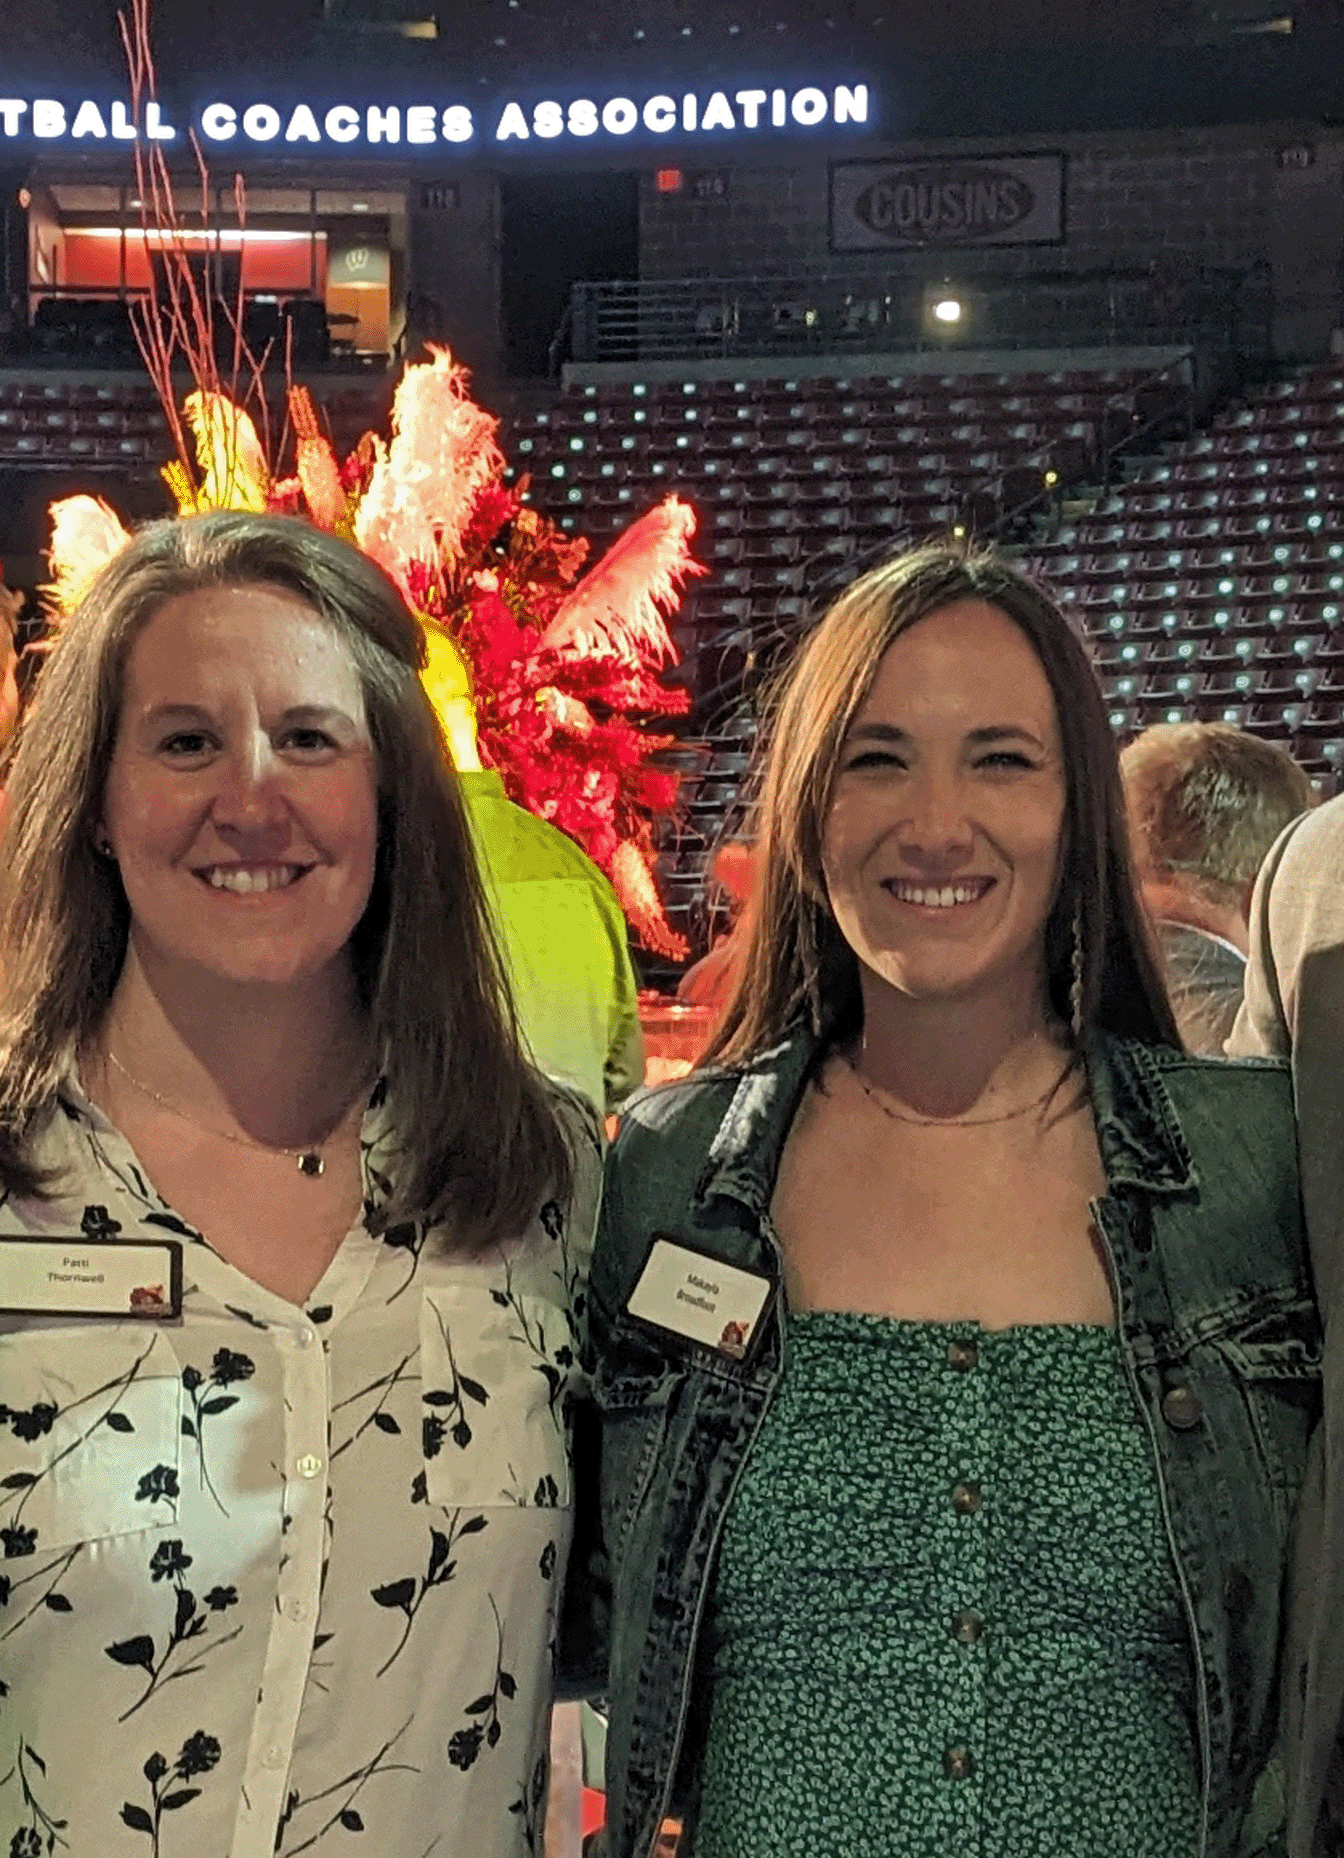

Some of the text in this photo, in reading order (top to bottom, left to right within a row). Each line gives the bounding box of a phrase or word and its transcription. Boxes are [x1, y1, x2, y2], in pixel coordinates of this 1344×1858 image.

[201, 103, 473, 144] COACHES
[496, 85, 868, 140] ASSOCIATION
[869, 179, 1018, 228] COUSINS
[62, 1257, 90, 1268] Patti
